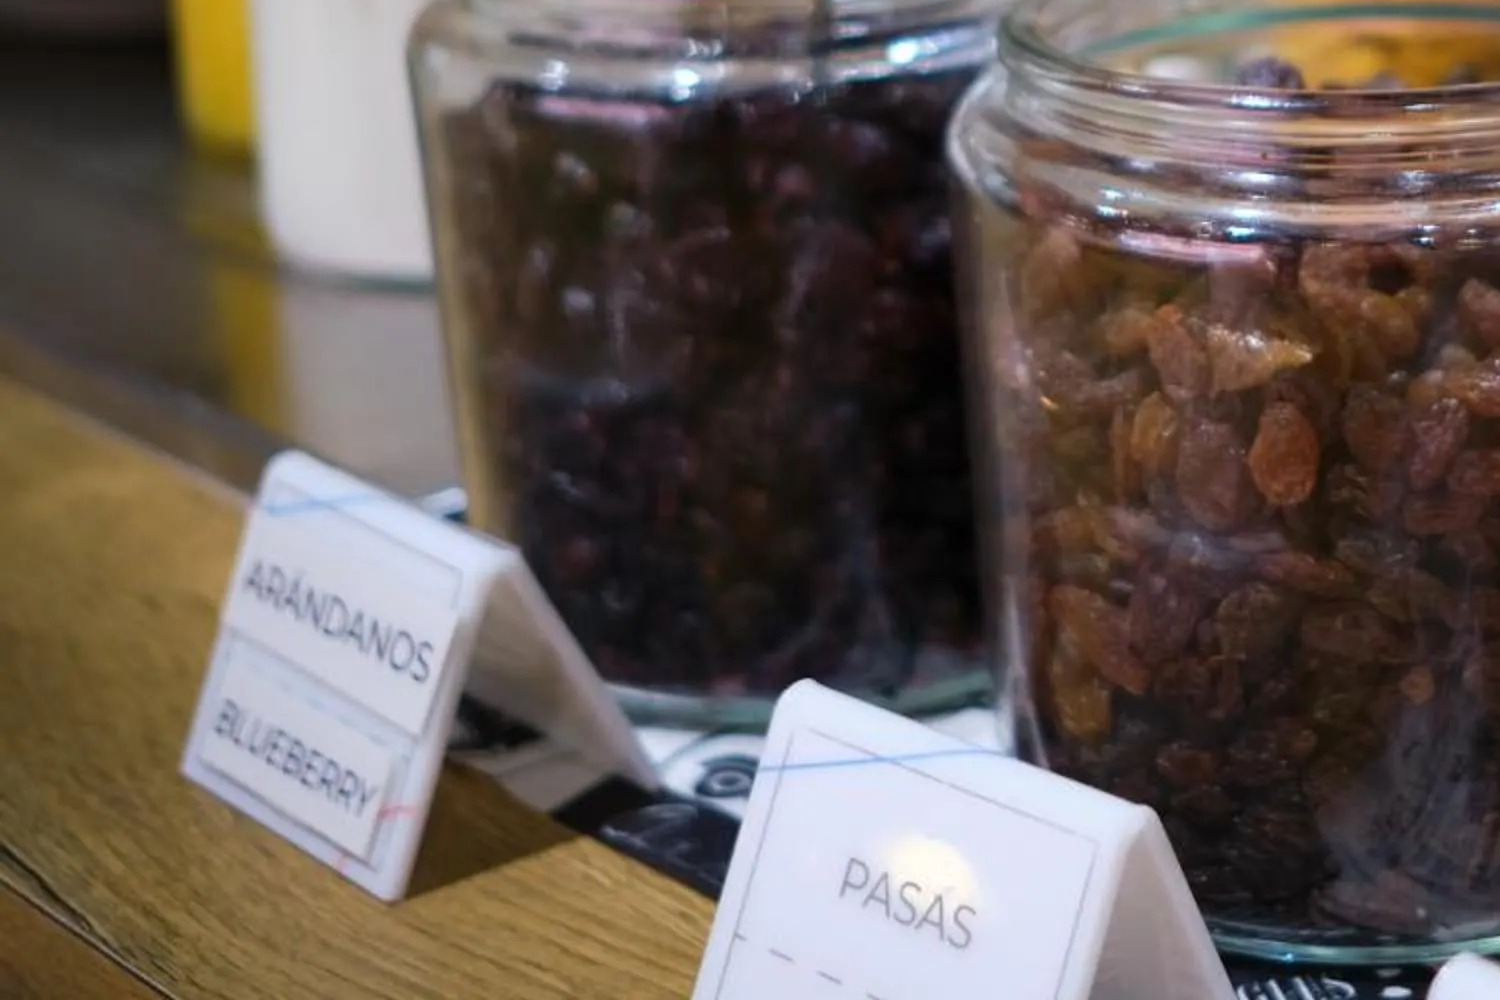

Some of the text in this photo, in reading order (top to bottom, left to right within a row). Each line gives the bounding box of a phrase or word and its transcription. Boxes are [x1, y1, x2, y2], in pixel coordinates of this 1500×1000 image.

[242, 559, 435, 684] ARÁNDANOS
[213, 698, 379, 819] BLUEBERRY
[838, 856, 978, 949] PASAS
